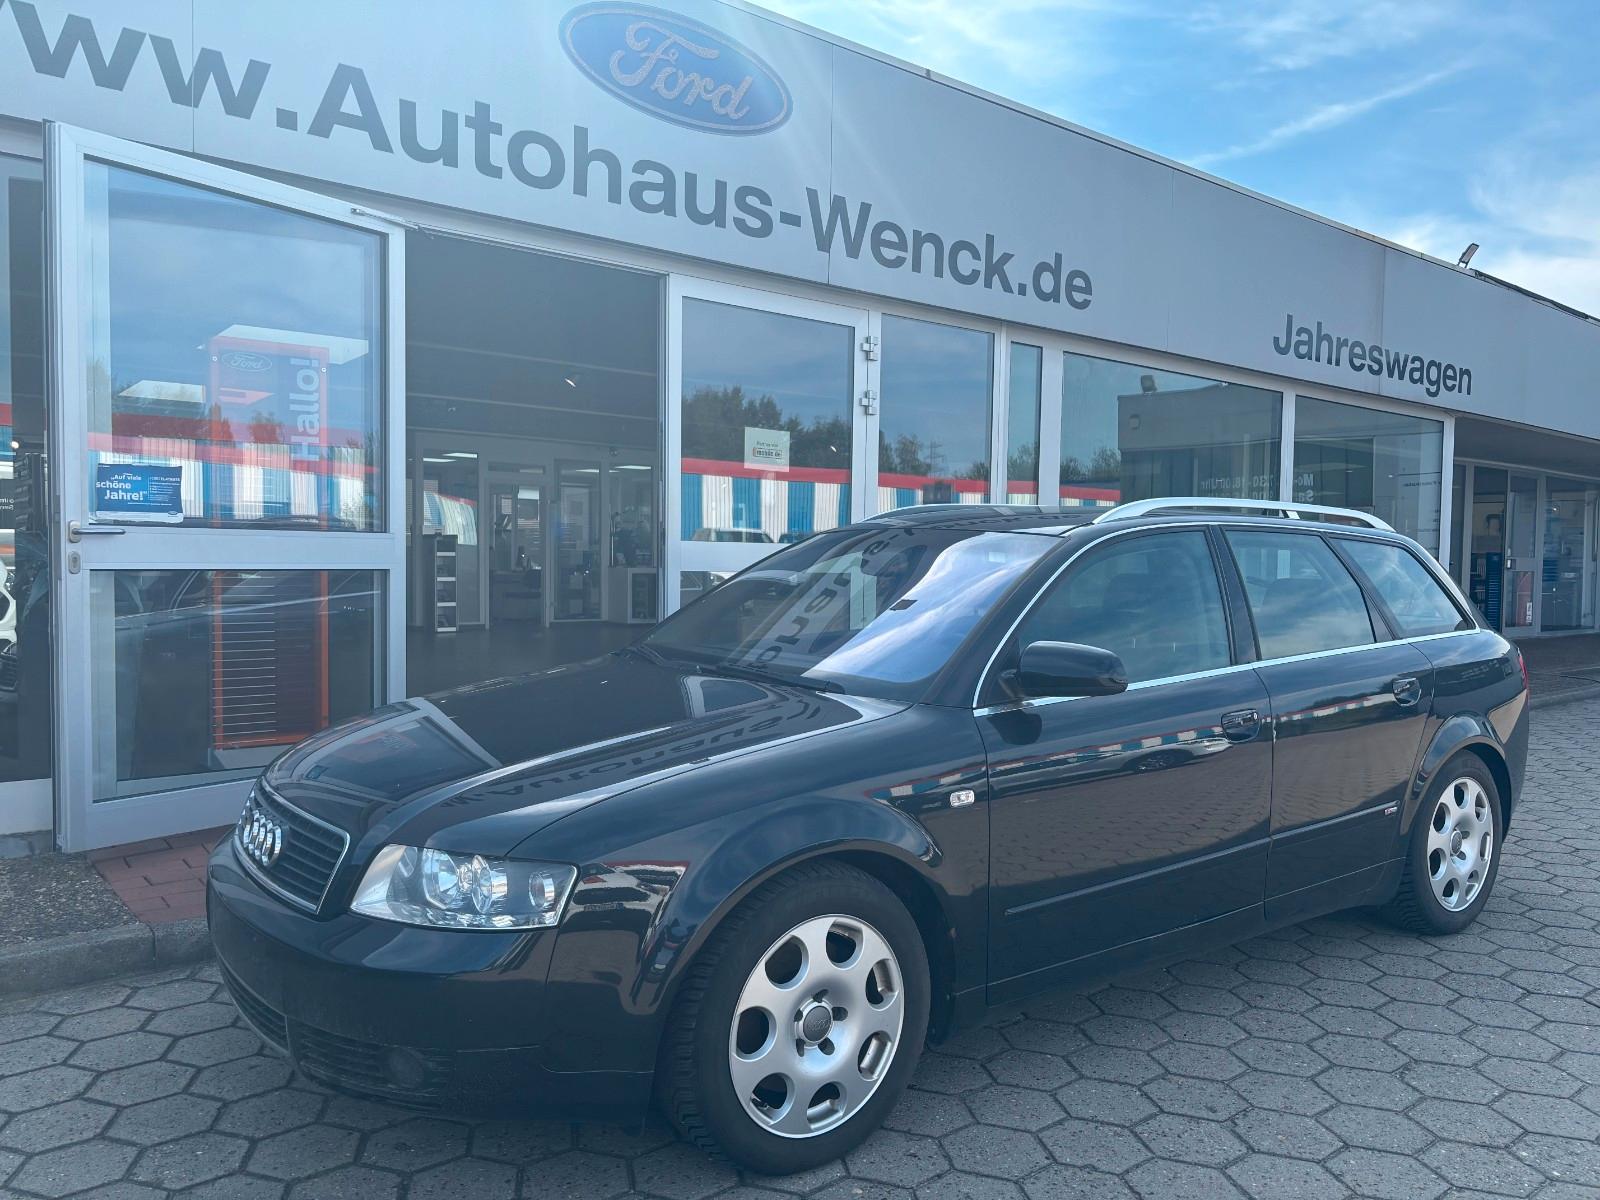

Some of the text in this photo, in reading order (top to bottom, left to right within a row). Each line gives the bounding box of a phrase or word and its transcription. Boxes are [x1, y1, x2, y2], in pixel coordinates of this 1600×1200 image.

[609, 21, 753, 120] Ford
[0, 0, 1093, 310] ww.Autohaus-Wenck.de
[231, 354, 264, 369] Ford
[1272, 313, 1473, 398] Jahreswagen
[289, 358, 320, 461] Hallo!
[95, 480, 132, 489] schöne
